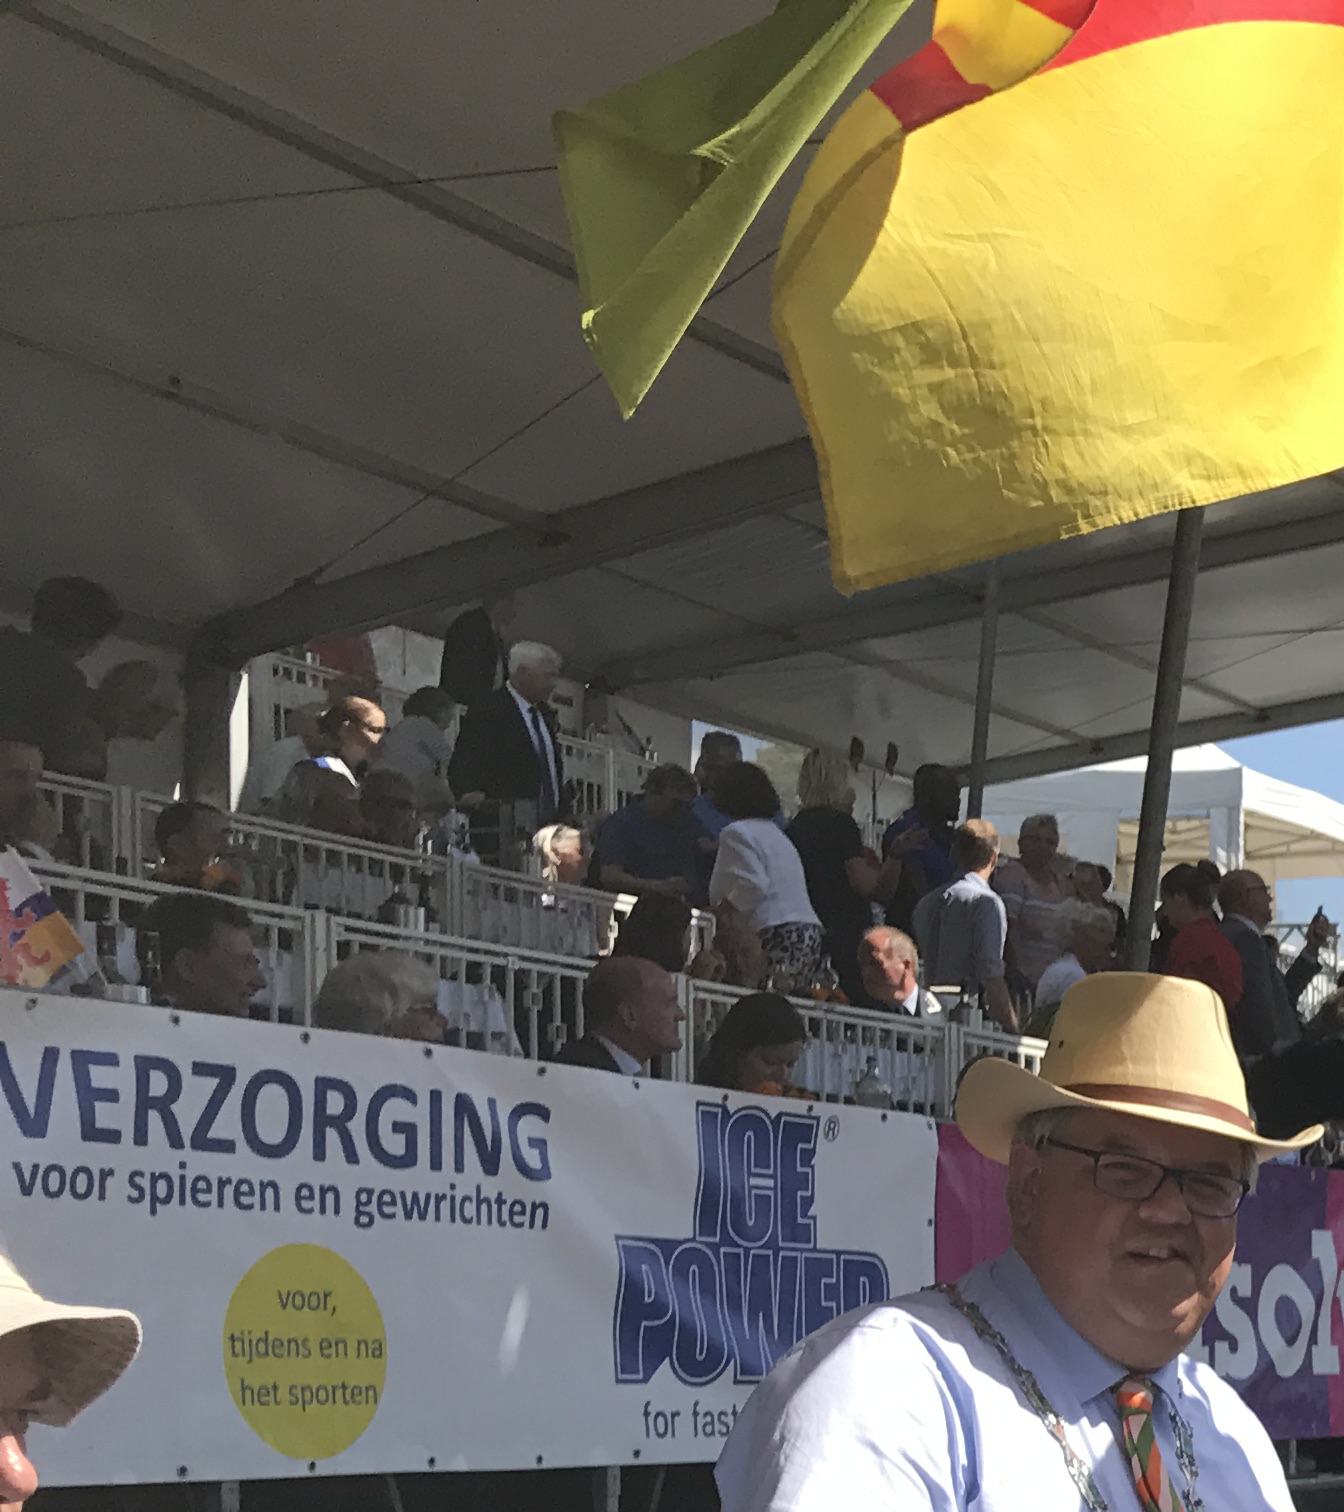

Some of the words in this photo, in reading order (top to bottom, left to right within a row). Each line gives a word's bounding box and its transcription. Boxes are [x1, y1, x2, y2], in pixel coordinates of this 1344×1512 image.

[0, 1041, 552, 1182] VERZORGING
[693, 1100, 821, 1249] ICE
[12, 1161, 115, 1201] voor
[127, 1160, 281, 1216] spieren
[294, 1182, 341, 1217] en
[353, 1182, 550, 1230] gewrichten
[277, 1289, 336, 1317] voor,
[228, 1329, 312, 1364] tijdens
[318, 1337, 348, 1360] en
[356, 1337, 384, 1360] na
[240, 1377, 281, 1407] het
[288, 1380, 379, 1413] sporten
[643, 1400, 680, 1440] for
